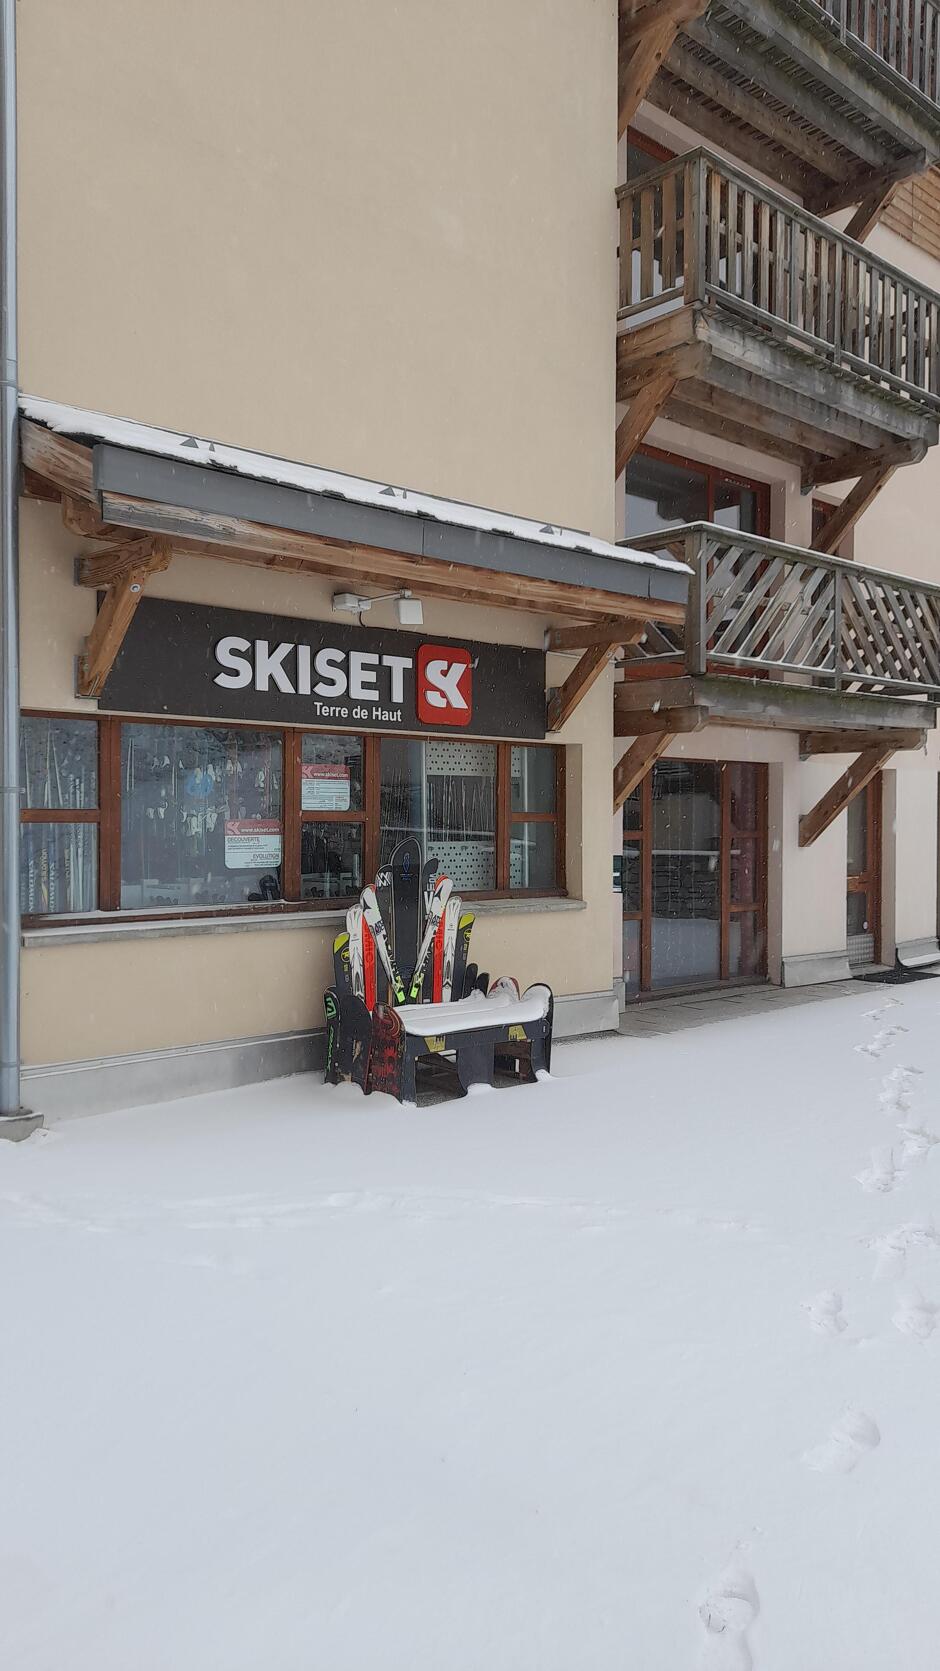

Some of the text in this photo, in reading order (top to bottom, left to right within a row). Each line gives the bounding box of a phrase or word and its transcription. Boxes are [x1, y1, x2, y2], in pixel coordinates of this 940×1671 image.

[214, 636, 413, 704] SKISET
[313, 701, 402, 722] Terre de Haut
